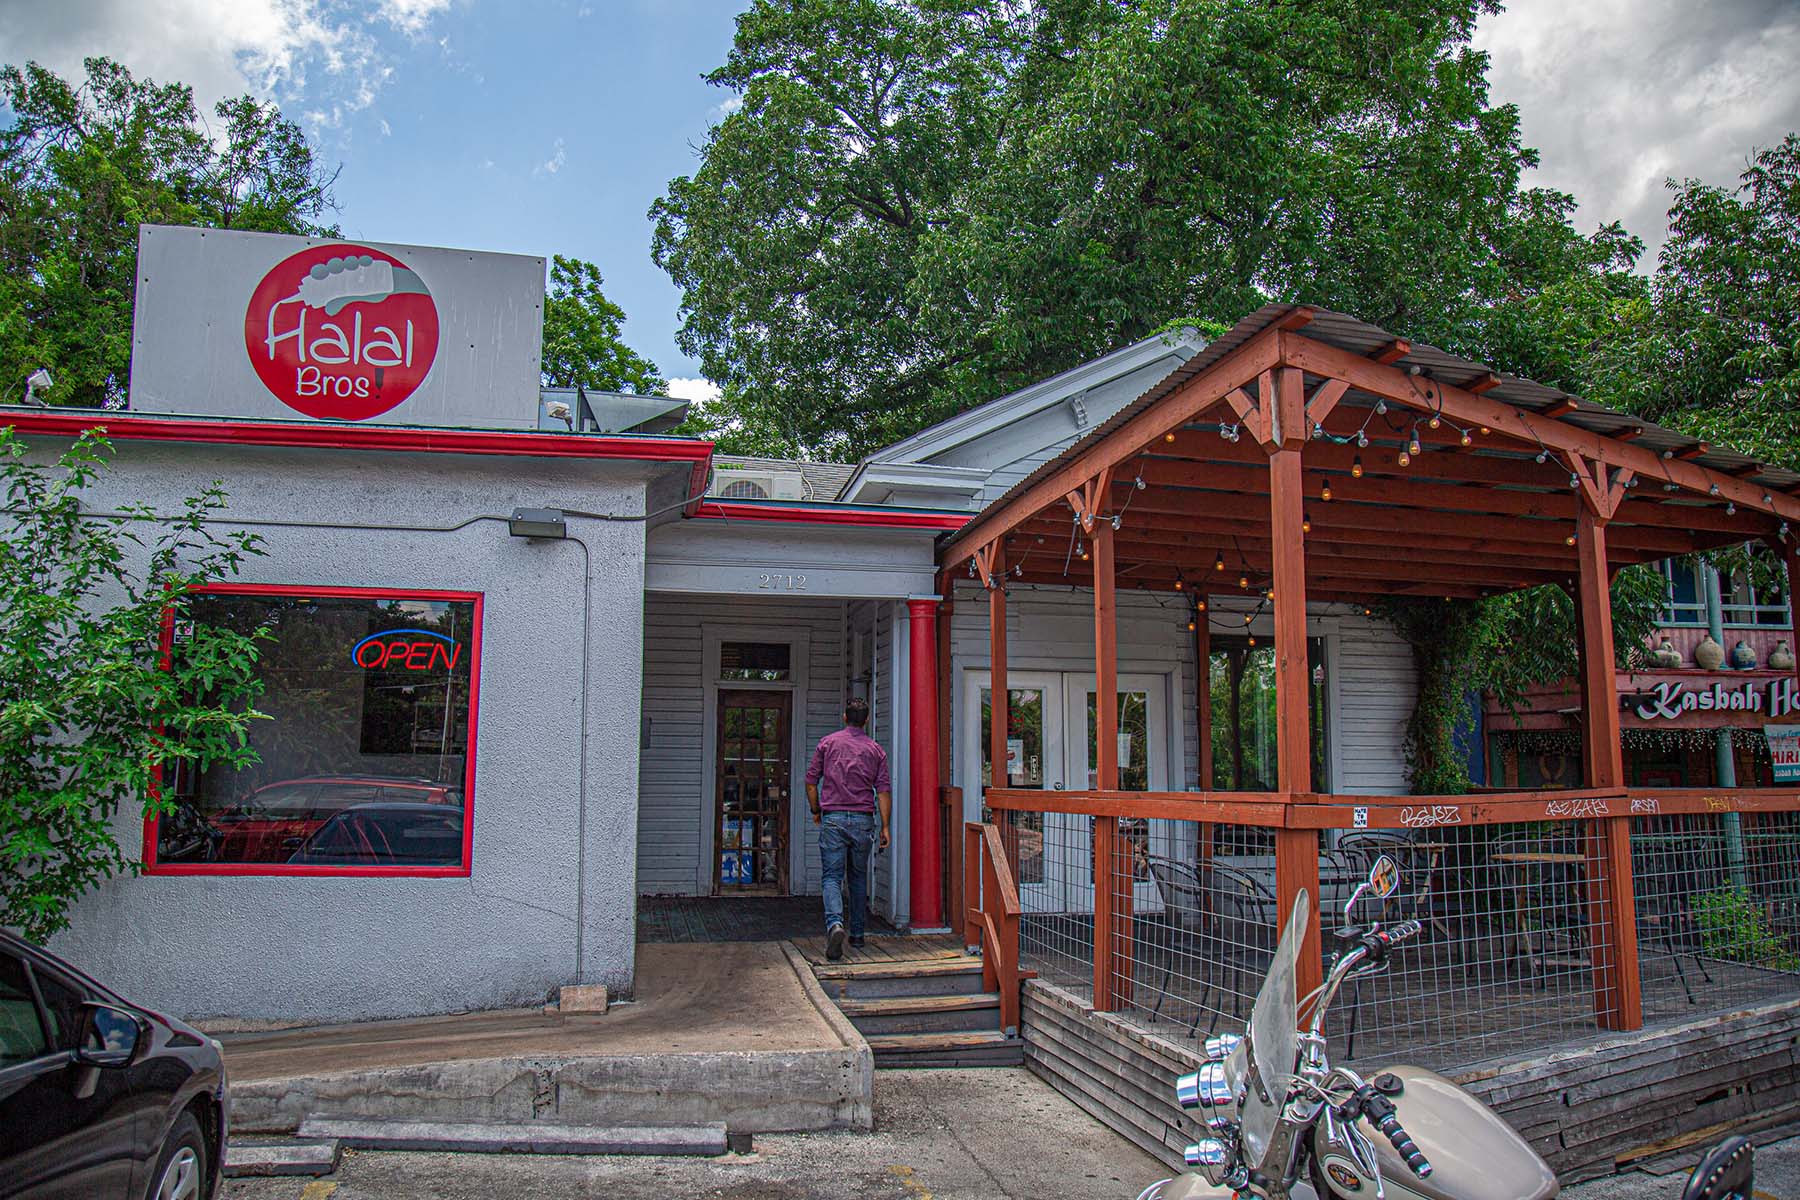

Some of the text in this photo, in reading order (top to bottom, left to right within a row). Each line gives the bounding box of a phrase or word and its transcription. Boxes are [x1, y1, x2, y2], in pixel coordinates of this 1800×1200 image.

[264, 301, 414, 368] Halal
[759, 574, 808, 590] 2712
[357, 640, 462, 670] OPEN
[1636, 682, 1762, 720] Kasbah
